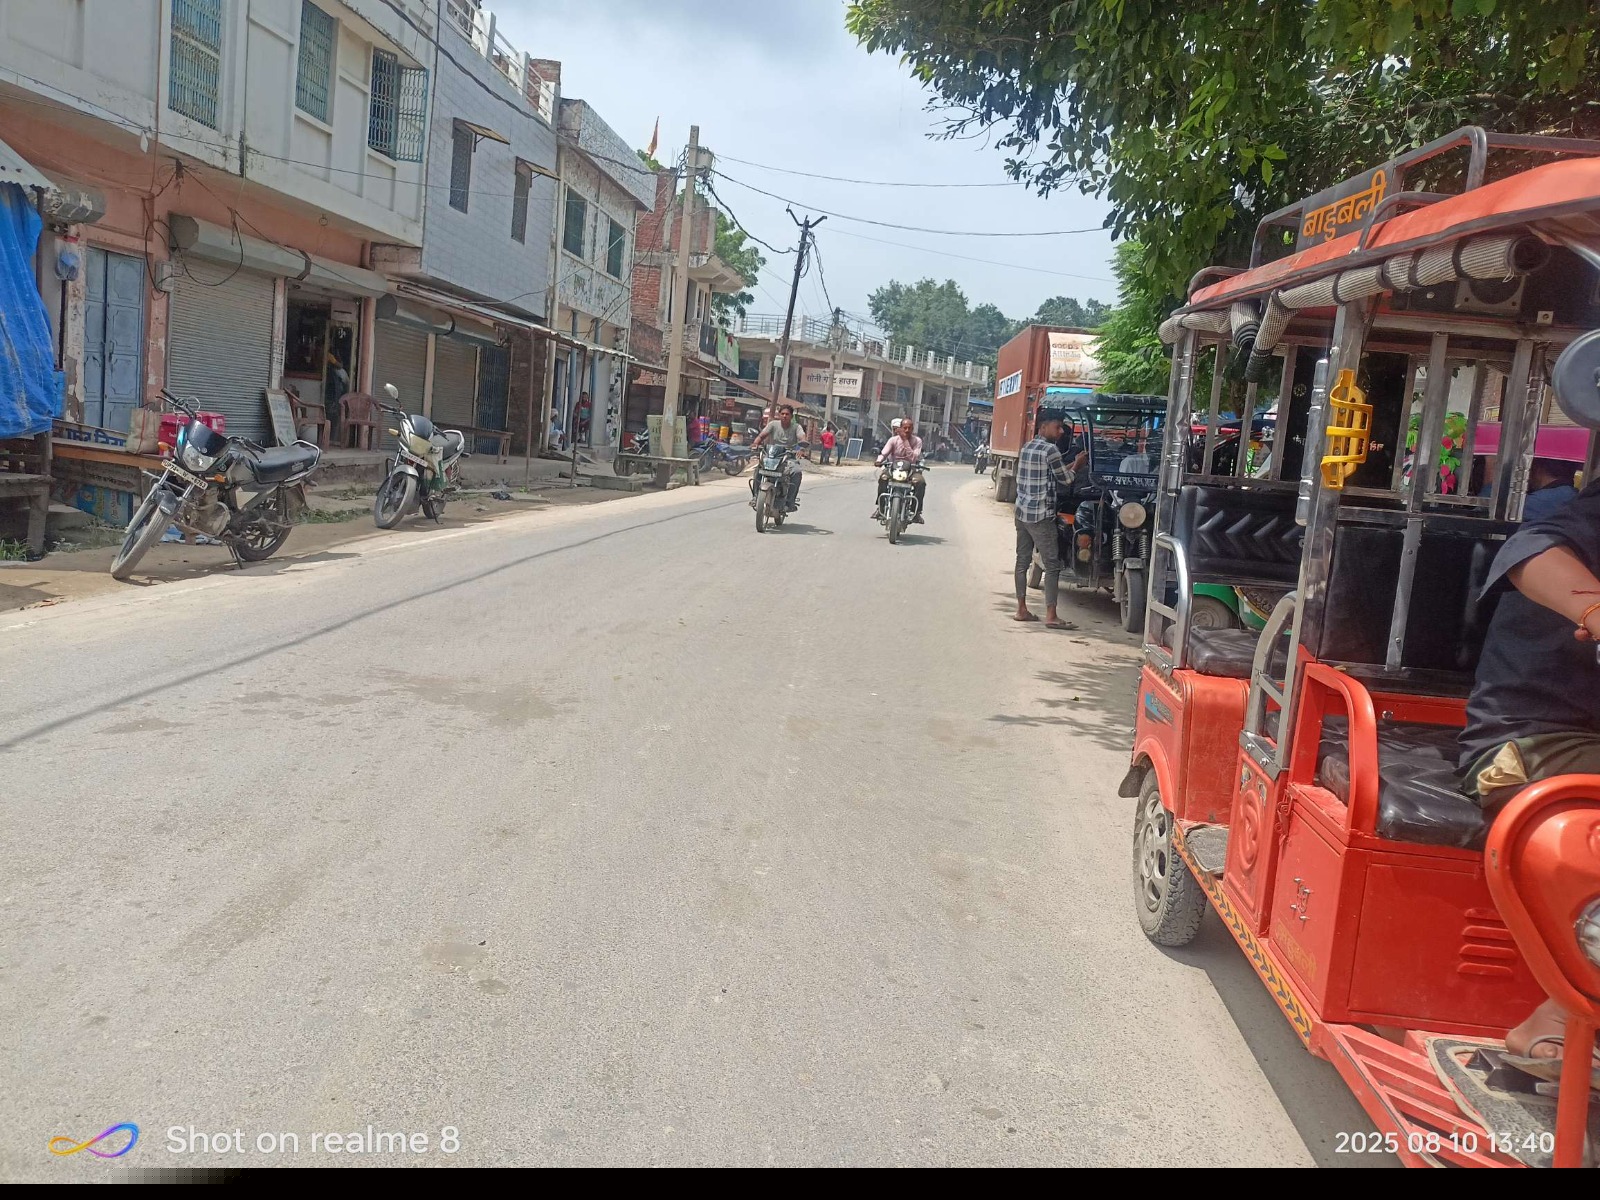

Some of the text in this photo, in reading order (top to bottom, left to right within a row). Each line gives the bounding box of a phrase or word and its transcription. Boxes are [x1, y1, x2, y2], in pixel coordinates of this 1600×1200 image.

[1303, 169, 1387, 240] बाहुबली
[806, 373, 821, 383] सोनी
[838, 377, 858, 386] हाउस
